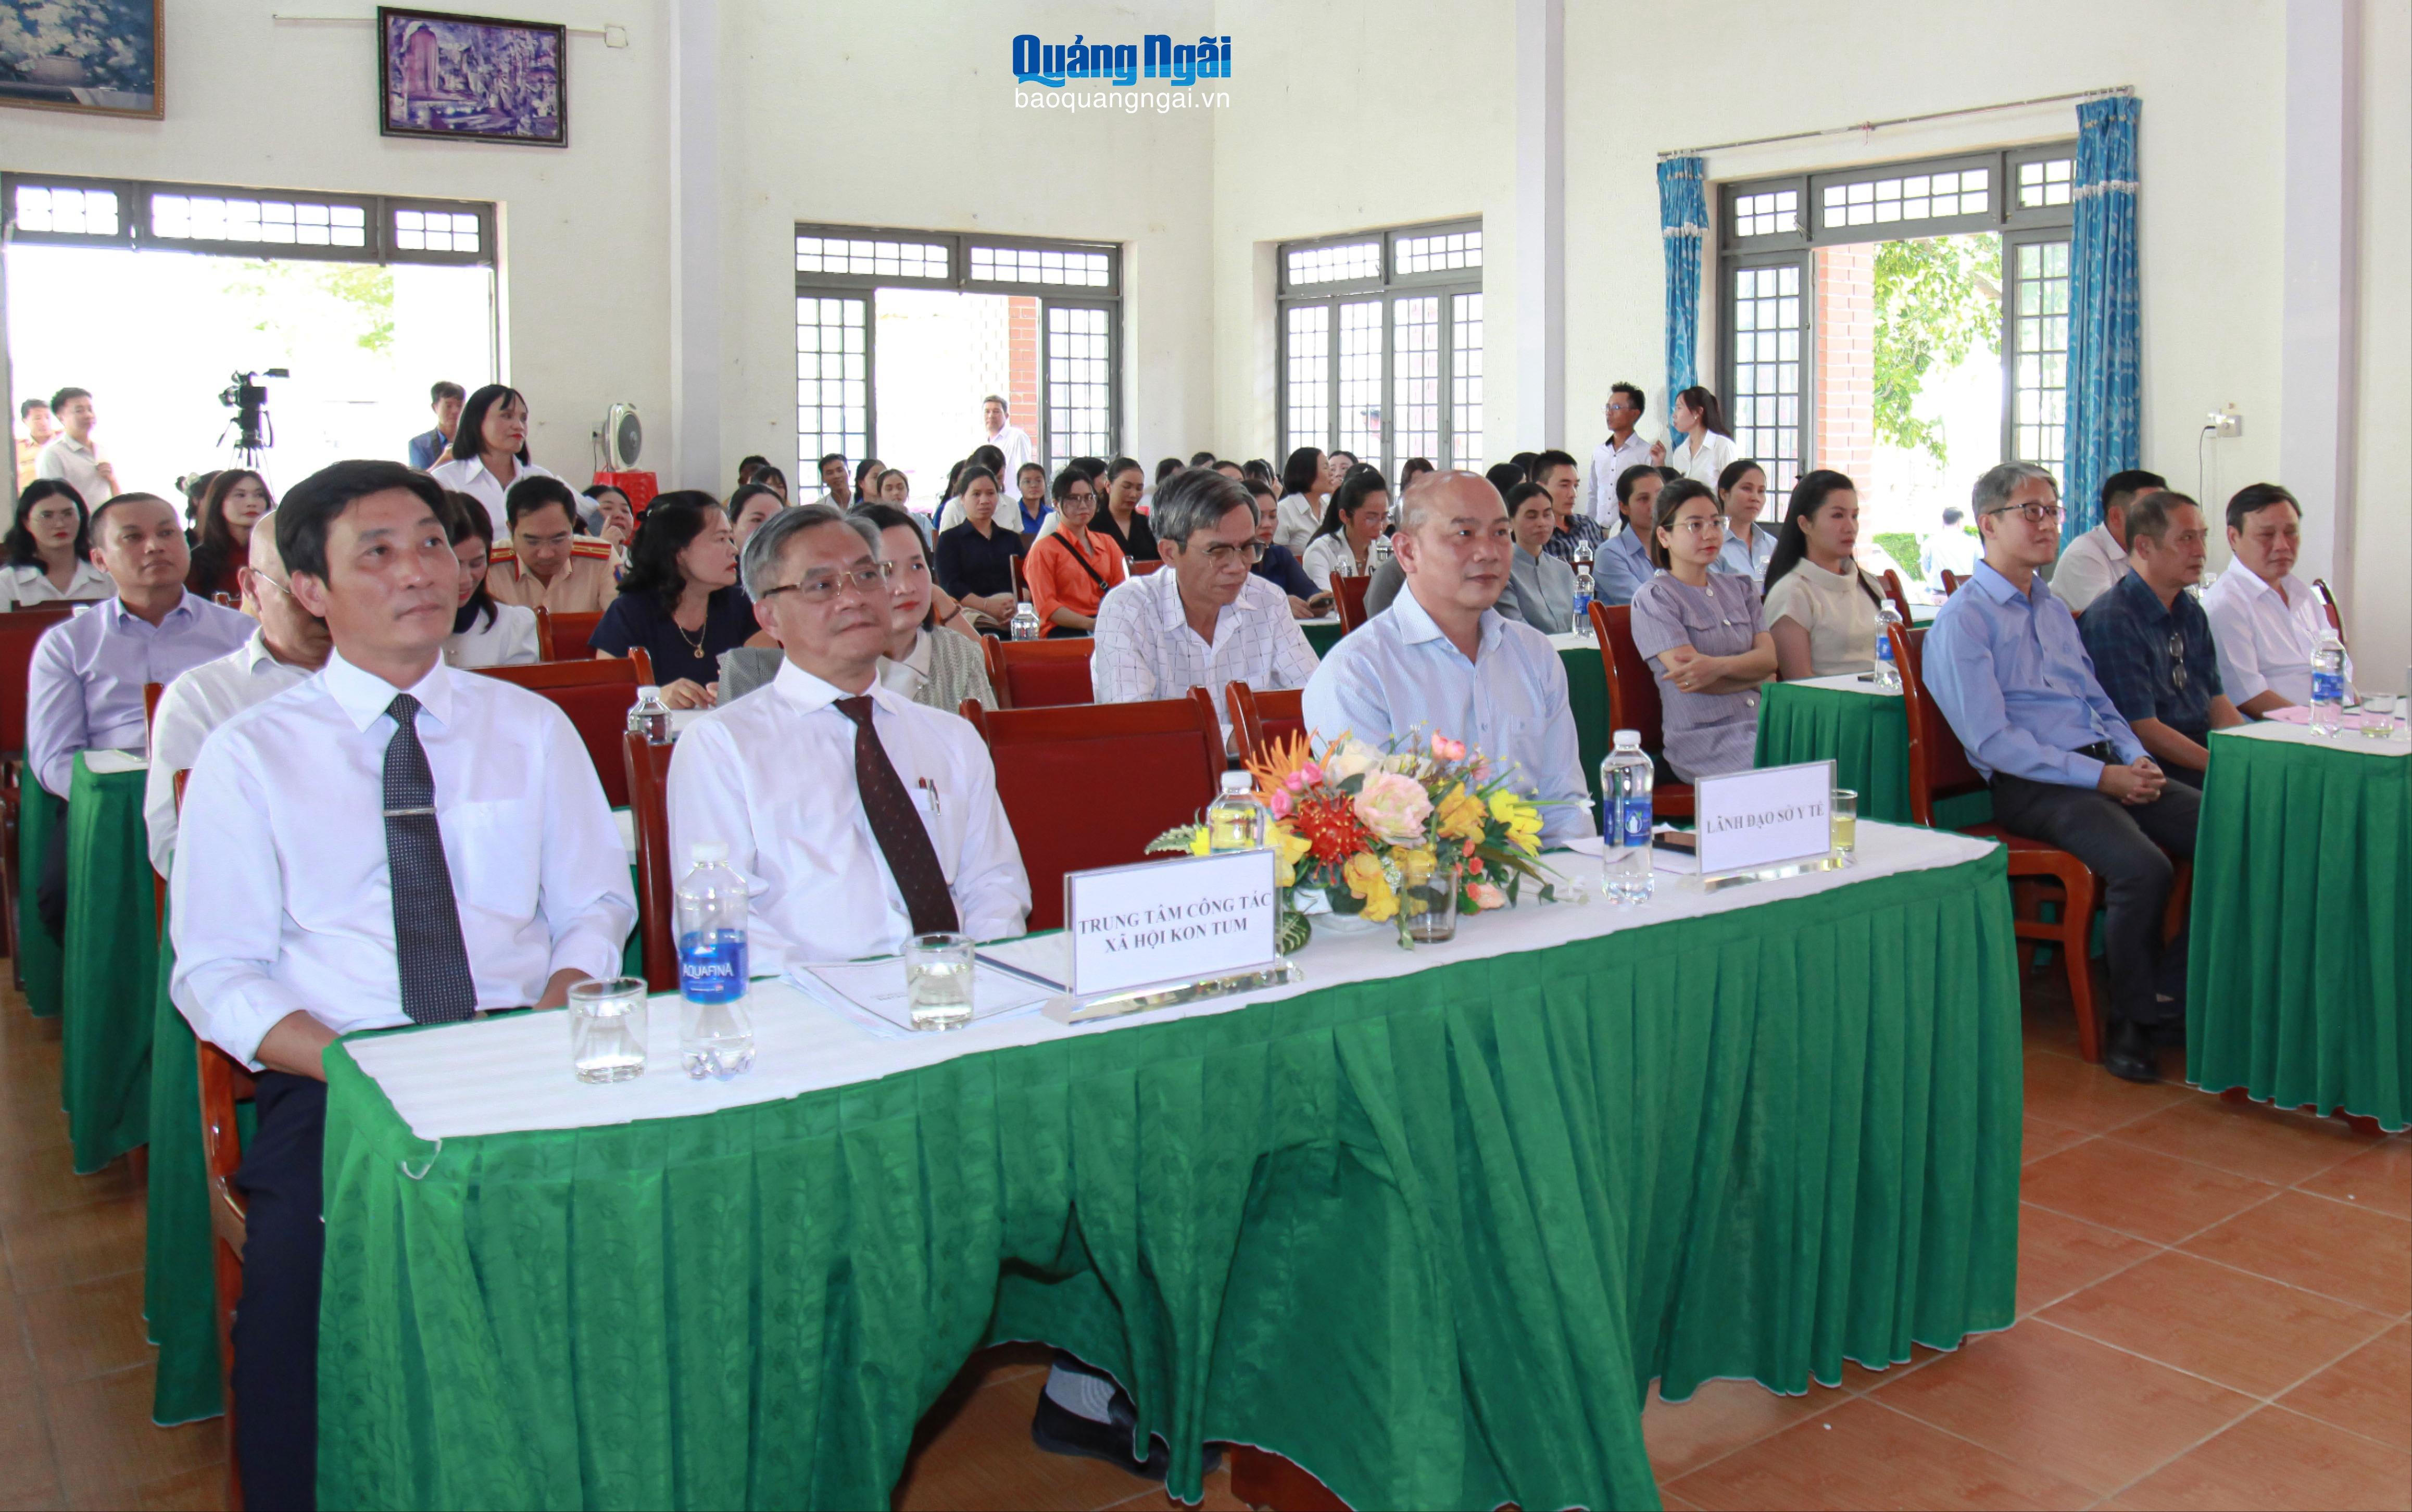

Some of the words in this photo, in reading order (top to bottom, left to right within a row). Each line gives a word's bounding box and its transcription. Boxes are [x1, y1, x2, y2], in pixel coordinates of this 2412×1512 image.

[1707, 816, 1743, 834] LÃNH
[1747, 811, 1774, 829] ĐẠO
[1777, 804, 1794, 822] SỞ
[1797, 806, 1805, 820] Y
[1078, 912, 1139, 934] TRUNG
[1145, 904, 1182, 924] TÂM
[1187, 898, 1234, 918] CÔNG
[1239, 890, 1271, 910] TÁC
[1105, 933, 1128, 953] XÃ
[1134, 929, 1165, 949] HỘI
[1171, 923, 1207, 942] KON
[1211, 917, 1247, 936] TUM
[683, 963, 734, 979] AQUAFINA
